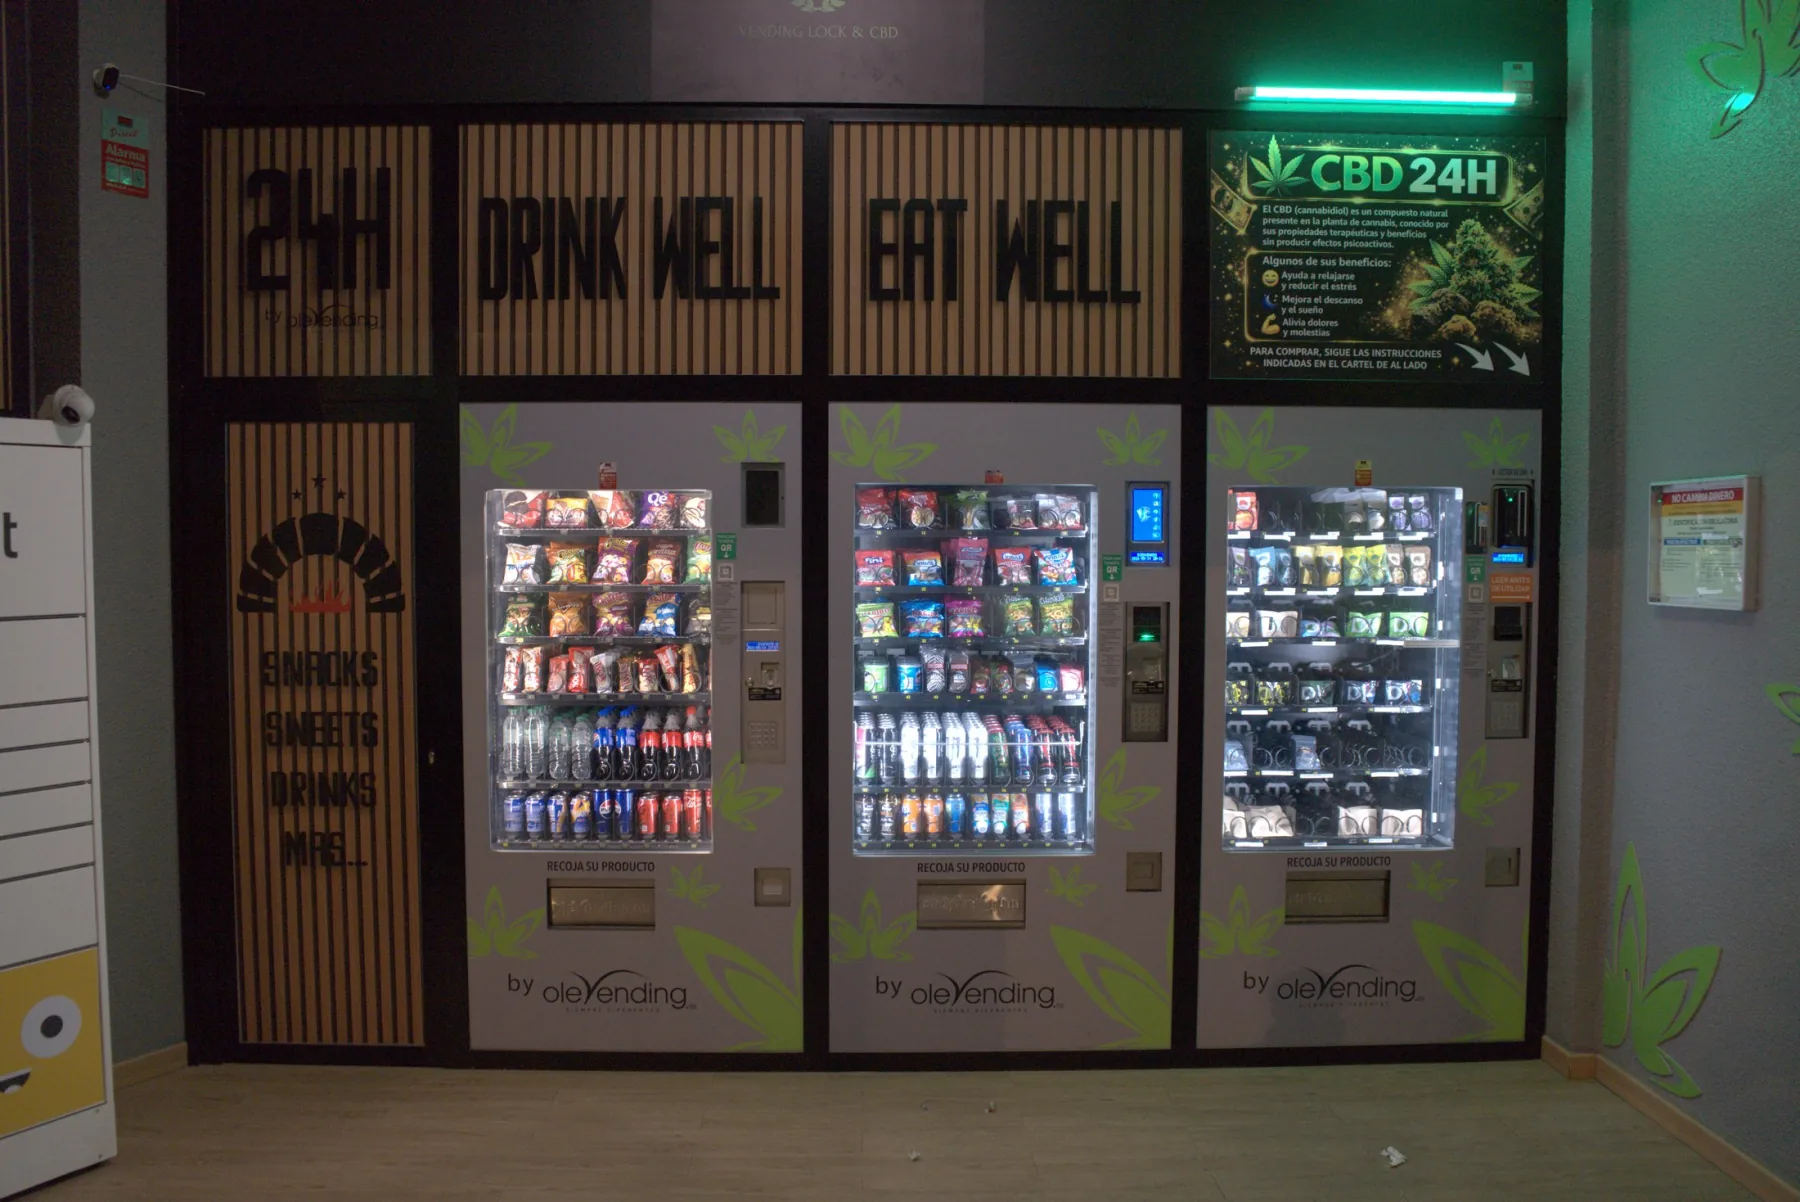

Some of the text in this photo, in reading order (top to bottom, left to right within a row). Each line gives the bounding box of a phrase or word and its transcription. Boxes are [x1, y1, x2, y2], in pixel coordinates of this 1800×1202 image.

[739, 25, 898, 39] VENDING LOCK & CBD
[106, 143, 146, 162] Alarma
[1311, 154, 1497, 195] CBD 24H
[1262, 205, 1272, 214] El
[1273, 205, 1293, 214] CBD
[1294, 206, 1349, 216] (cannabidiol)
[1373, 209, 1419, 219] compuesto
[1420, 209, 1449, 218] natural
[248, 168, 391, 290] 24H
[1262, 218, 1299, 226] presente
[1312, 217, 1321, 225] la
[1322, 217, 1348, 227] planta
[1349, 217, 1360, 226] de
[1361, 218, 1398, 228] cannabis,
[1399, 220, 1434, 228] conocido
[1435, 221, 1450, 229] por
[1277, 228, 1329, 237] propiedades
[1329, 228, 1379, 238] terapéuticas
[1380, 231, 1386, 239] y
[1386, 229, 1427, 238] beneficios
[478, 197, 781, 300] DRINK WELL
[1276, 239, 1311, 247] producir
[1312, 239, 1343, 247] efectos
[1343, 240, 1394, 249] psicoactivos.
[870, 199, 1142, 303] EAT WELL
[1262, 256, 1392, 268] Algunos de sus beneficios:
[1281, 271, 1309, 281] Ayuda
[1318, 272, 1356, 282] relajarse
[1288, 282, 1320, 290] reducir
[1321, 282, 1330, 290] el
[1330, 282, 1357, 291] estrés
[1281, 295, 1364, 306] Mejora el descanso
[1281, 306, 1324, 315] y el sueño
[1282, 318, 1339, 327] Alivia dolores
[1289, 329, 1331, 337] molestias
[1250, 347, 1442, 358] PARA COMPRAR, SIGUE LAS INSTRUCCIONES
[1263, 359, 1427, 370] INDICADAS EN EL CARTEL DE AL LADO
[648, 492, 668, 506] Qé
[1672, 493, 1682, 504] NO
[1708, 490, 1735, 502] DINERO
[720, 544, 732, 552] QR
[1106, 566, 1118, 574] QR
[1470, 567, 1481, 575] QR
[262, 651, 378, 687] SNACKS
[266, 712, 378, 747] SWEETS
[271, 772, 377, 807] DRINKS
[547, 861, 655, 872] RECOJA SU PRODUCTO
[917, 862, 1025, 873] RECOJA SU PRODUCTO
[1287, 856, 1391, 868] RECOJA SU PRODUCTO
[508, 973, 534, 996] by
[876, 976, 902, 998] by
[1243, 971, 1269, 994] by
